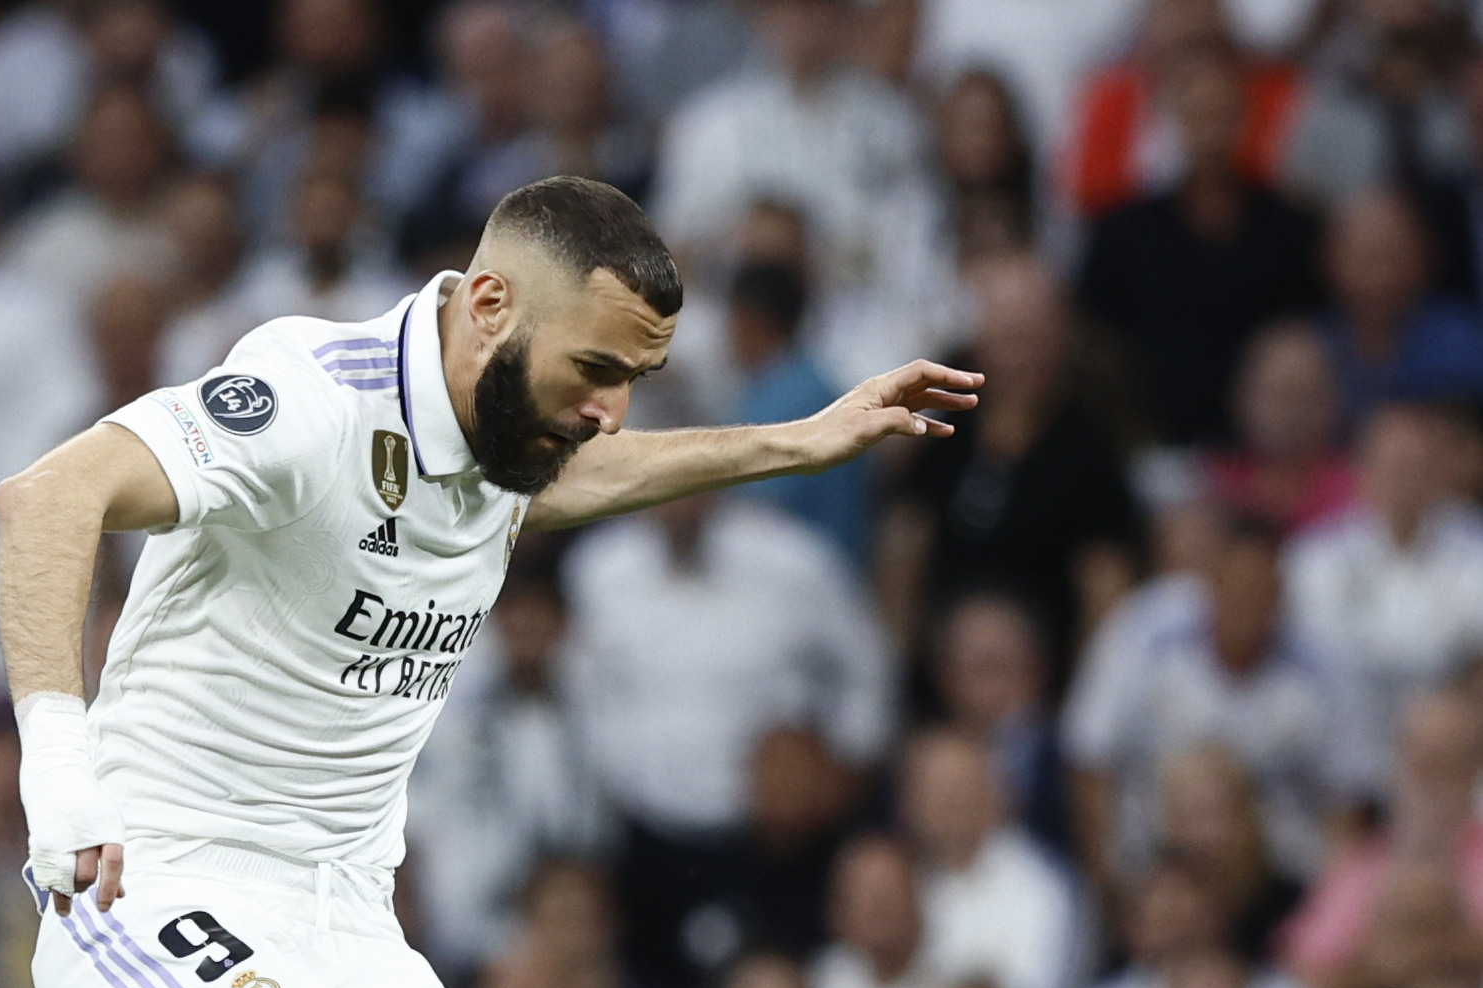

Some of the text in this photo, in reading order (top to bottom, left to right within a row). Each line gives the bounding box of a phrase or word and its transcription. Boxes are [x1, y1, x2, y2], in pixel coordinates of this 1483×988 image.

[218, 389, 243, 412] 14
[382, 480, 401, 495] FIFA
[358, 538, 399, 557] adidas
[334, 588, 489, 654] Emirat
[340, 653, 395, 694] FLY
[158, 910, 255, 983] 9
